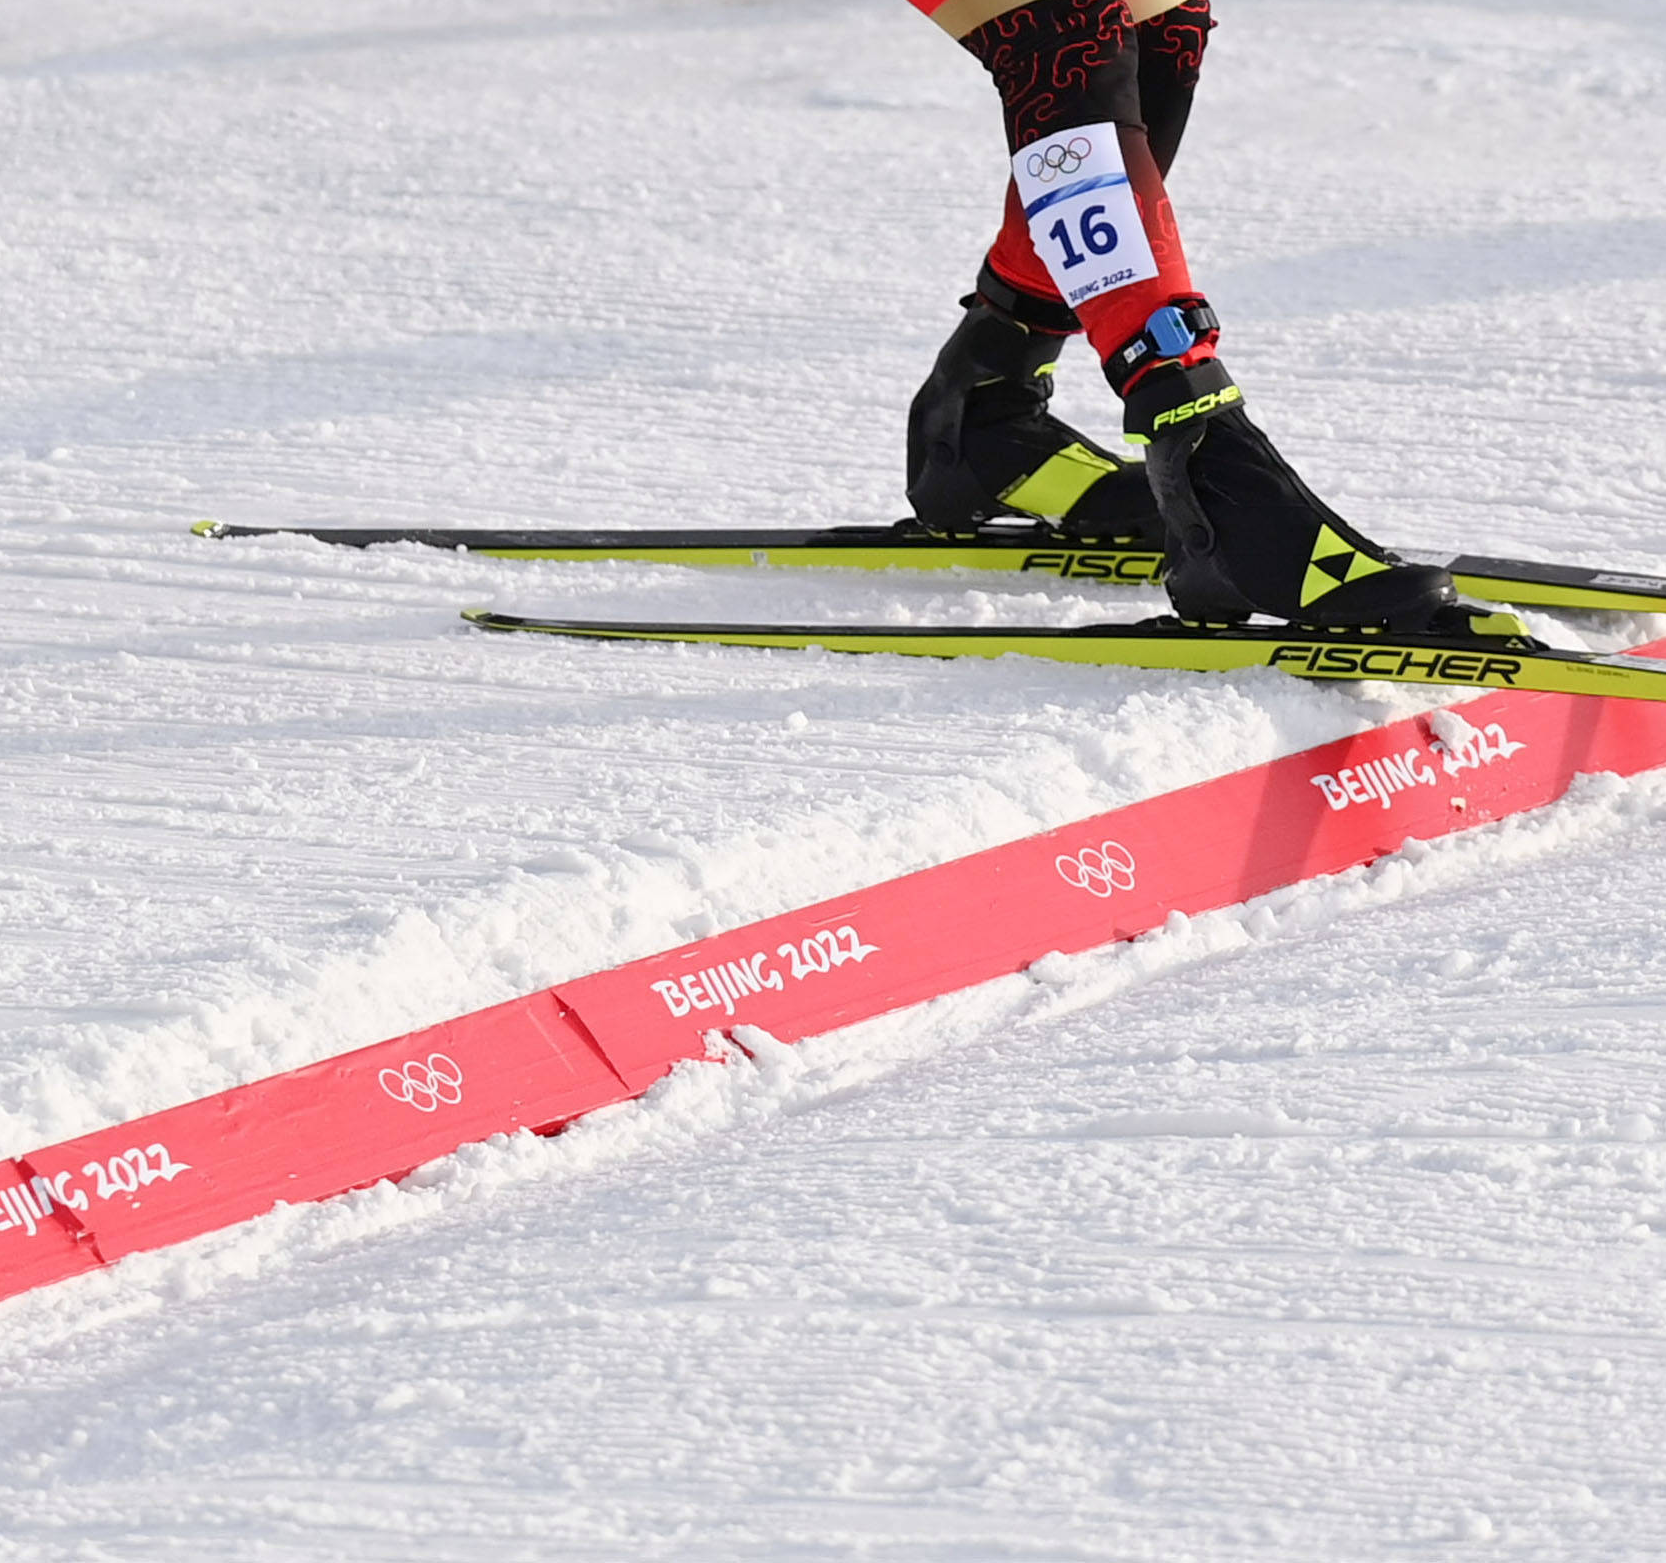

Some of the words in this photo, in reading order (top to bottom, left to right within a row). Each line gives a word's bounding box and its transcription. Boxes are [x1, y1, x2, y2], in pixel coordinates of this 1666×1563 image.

[1049, 205, 1118, 270] 16
[1102, 268, 1138, 288] 2022
[1154, 384, 1241, 432] FISCHE
[1020, 553, 1164, 581] FISC
[1267, 645, 1522, 685] FISCHER
[1310, 748, 1437, 811] BEIJING
[649, 951, 785, 1018] BEIJING
[777, 925, 882, 980] 2022
[81, 1142, 194, 1200] 2022
